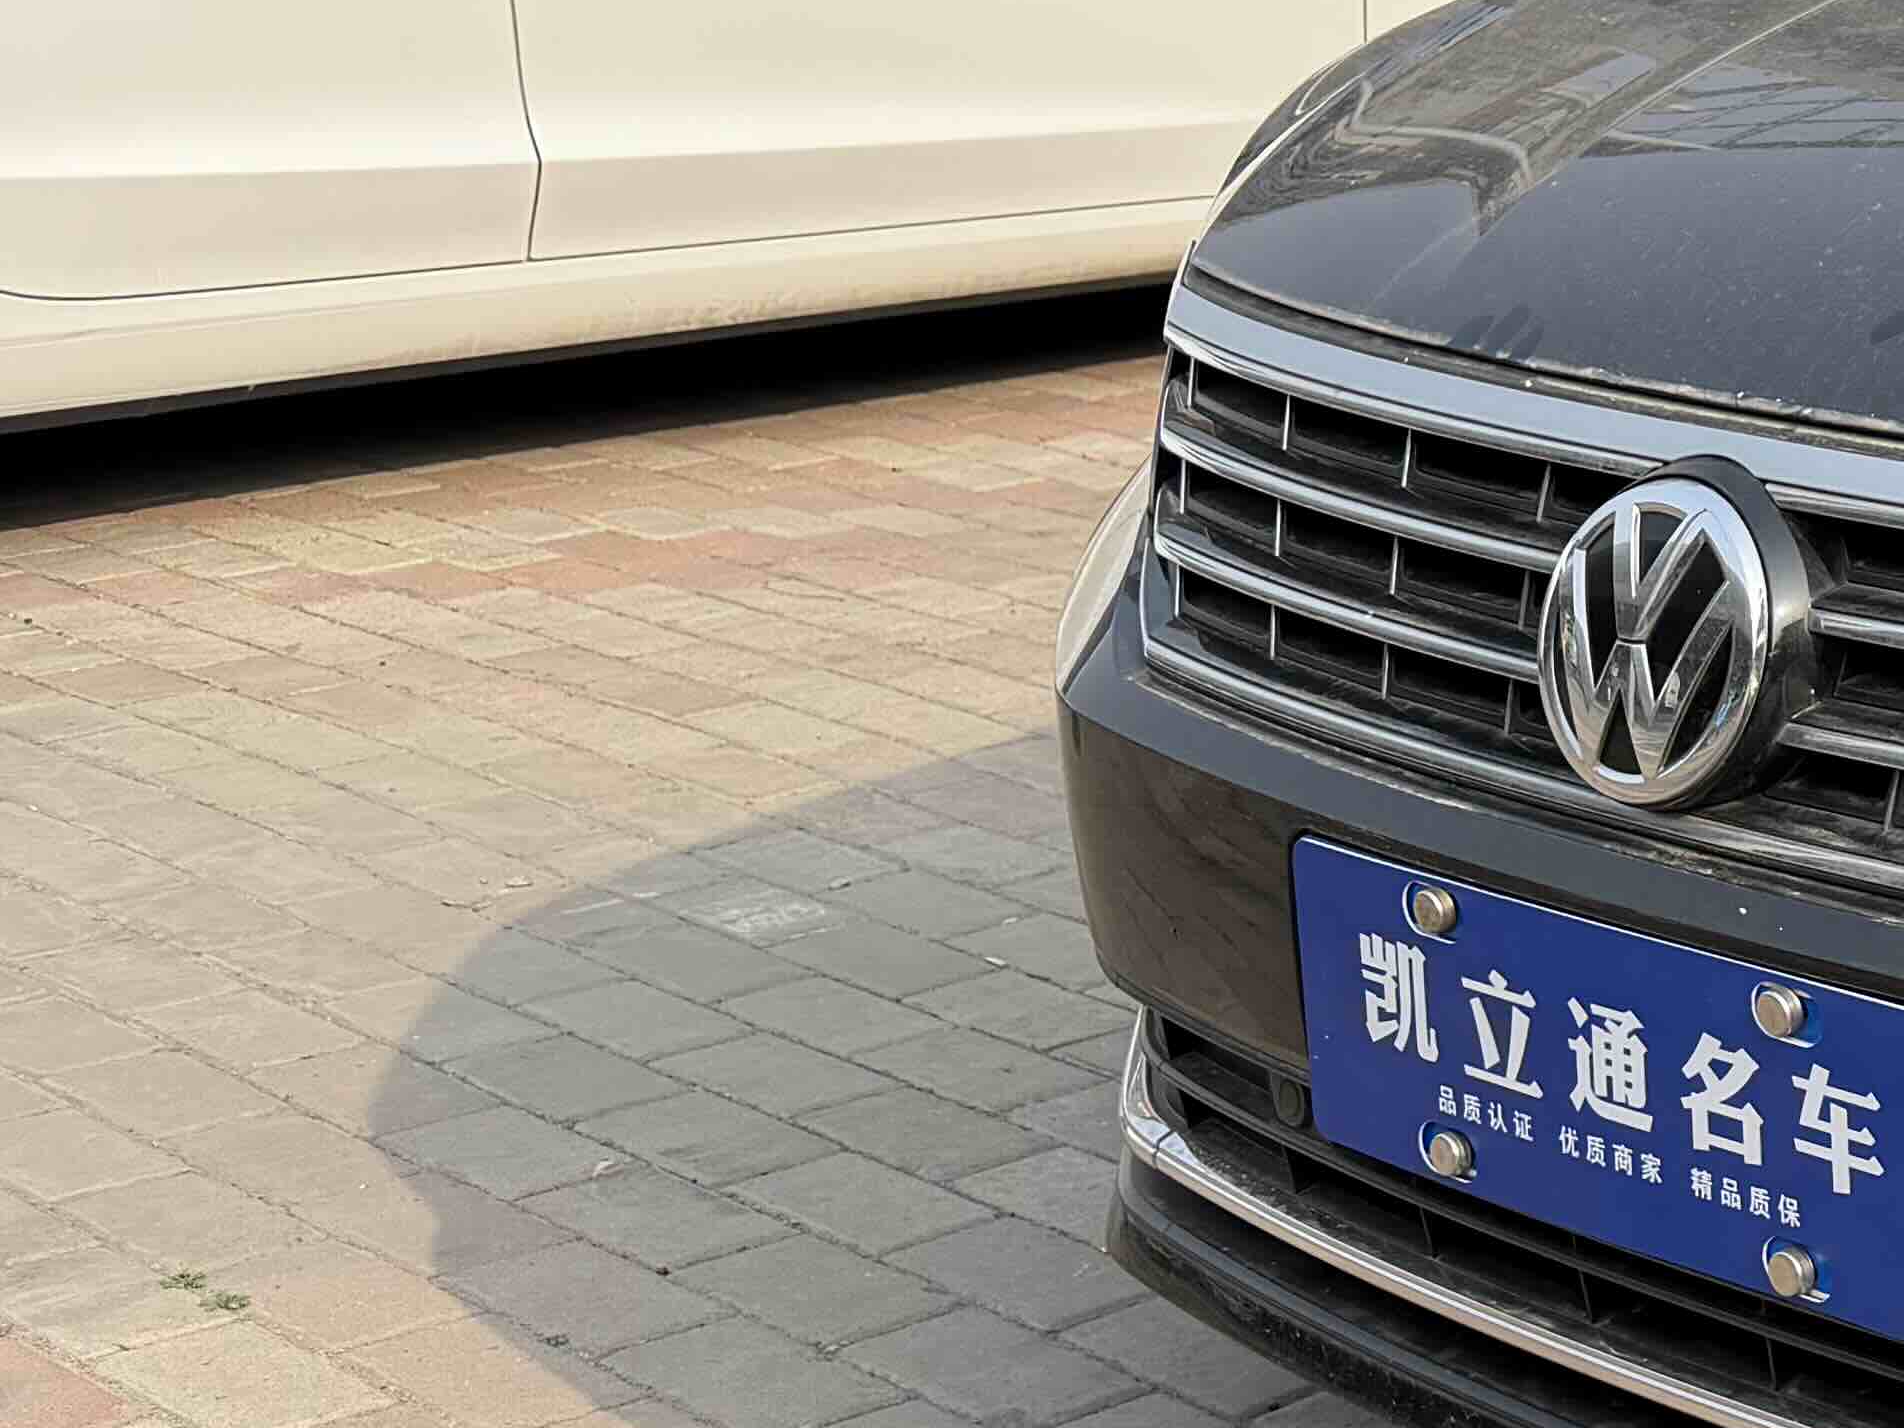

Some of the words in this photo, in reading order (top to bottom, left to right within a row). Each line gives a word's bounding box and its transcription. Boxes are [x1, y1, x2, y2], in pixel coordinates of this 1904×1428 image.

[1359, 931, 1885, 1195] 凯立通名车
[1438, 1084, 1535, 1143] 品质认证
[1558, 1124, 1664, 1185] 优质商家
[1689, 1168, 1802, 1228] 精品质保
